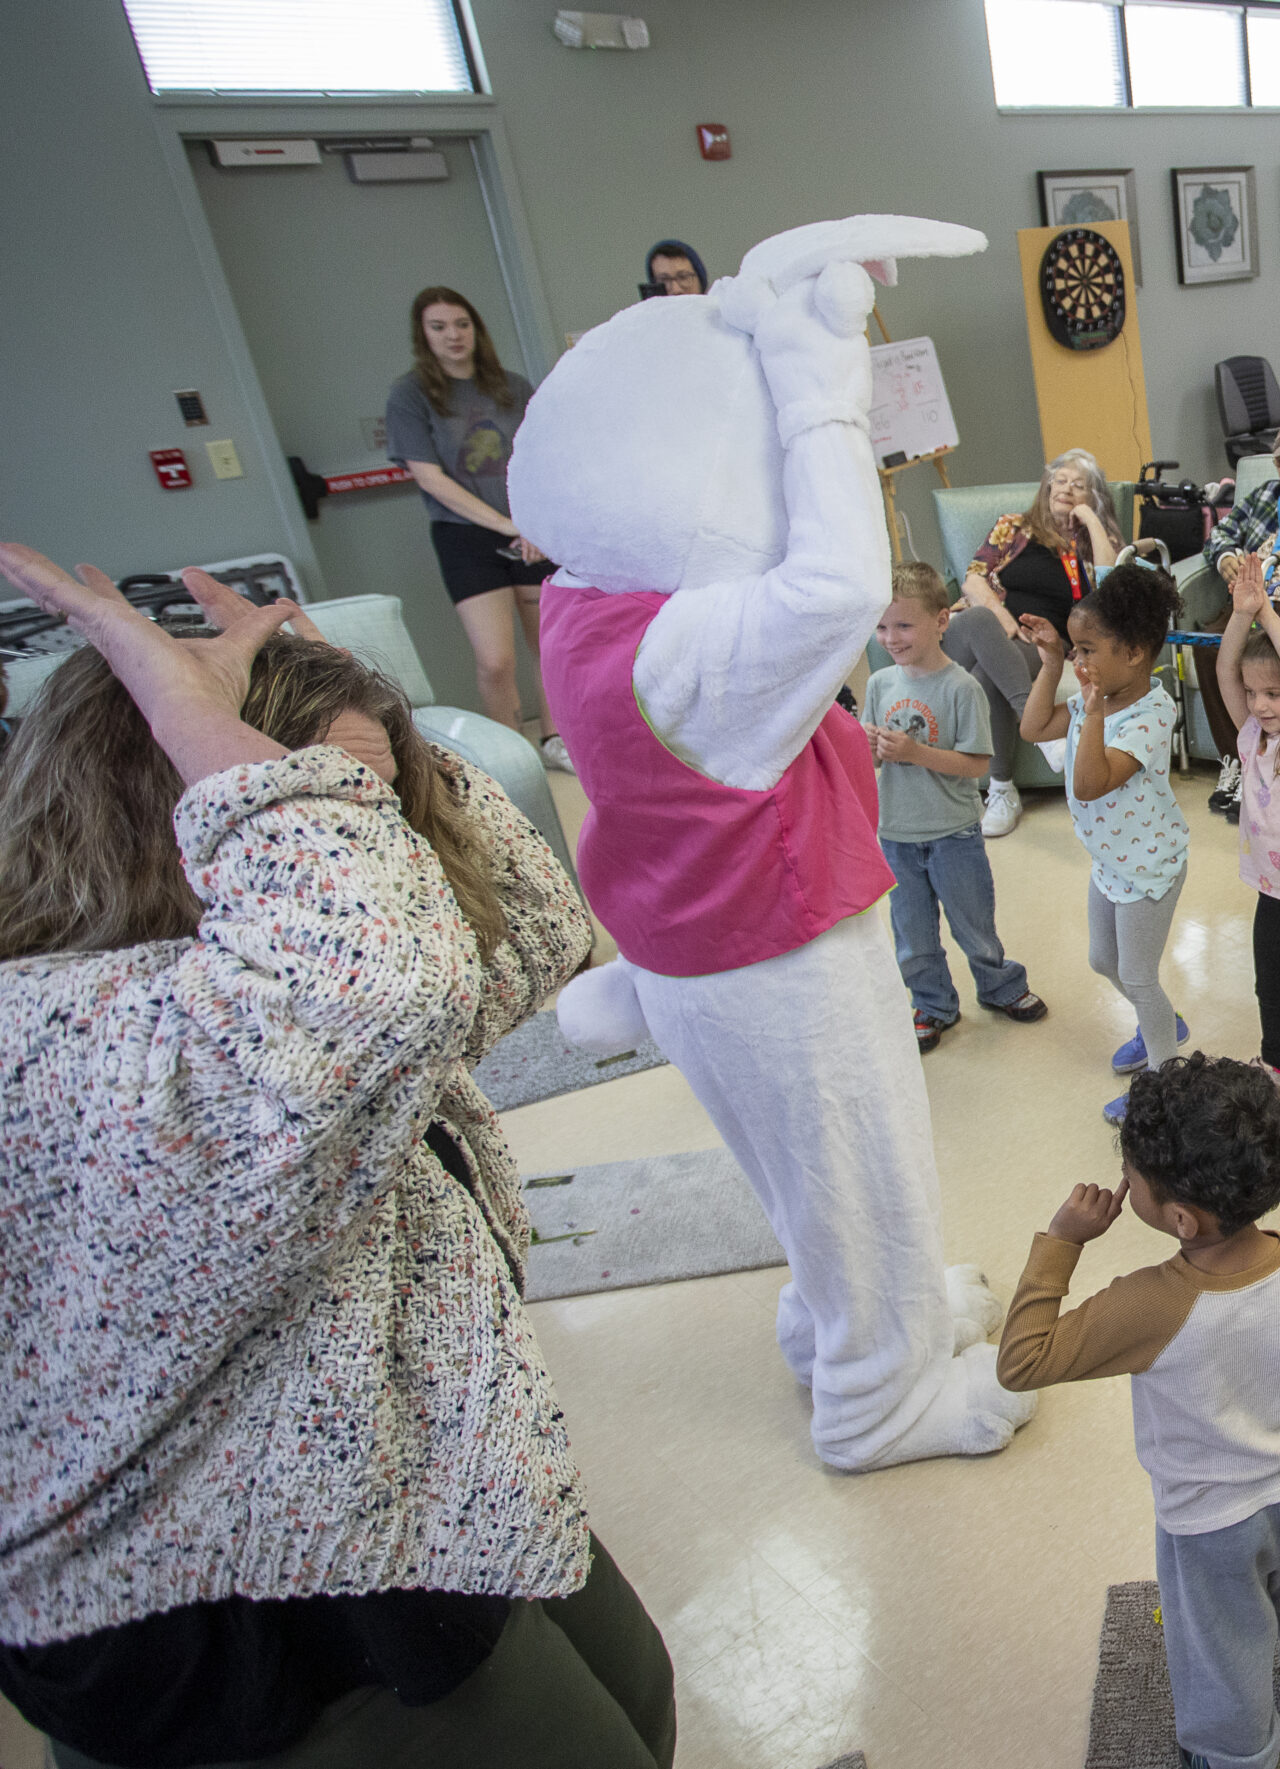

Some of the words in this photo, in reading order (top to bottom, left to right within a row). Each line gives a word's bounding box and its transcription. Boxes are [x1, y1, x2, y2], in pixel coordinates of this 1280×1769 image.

[353, 477, 366, 488] TO
[366, 474, 388, 486] OPEN
[912, 699, 939, 743] OUTDOORS
